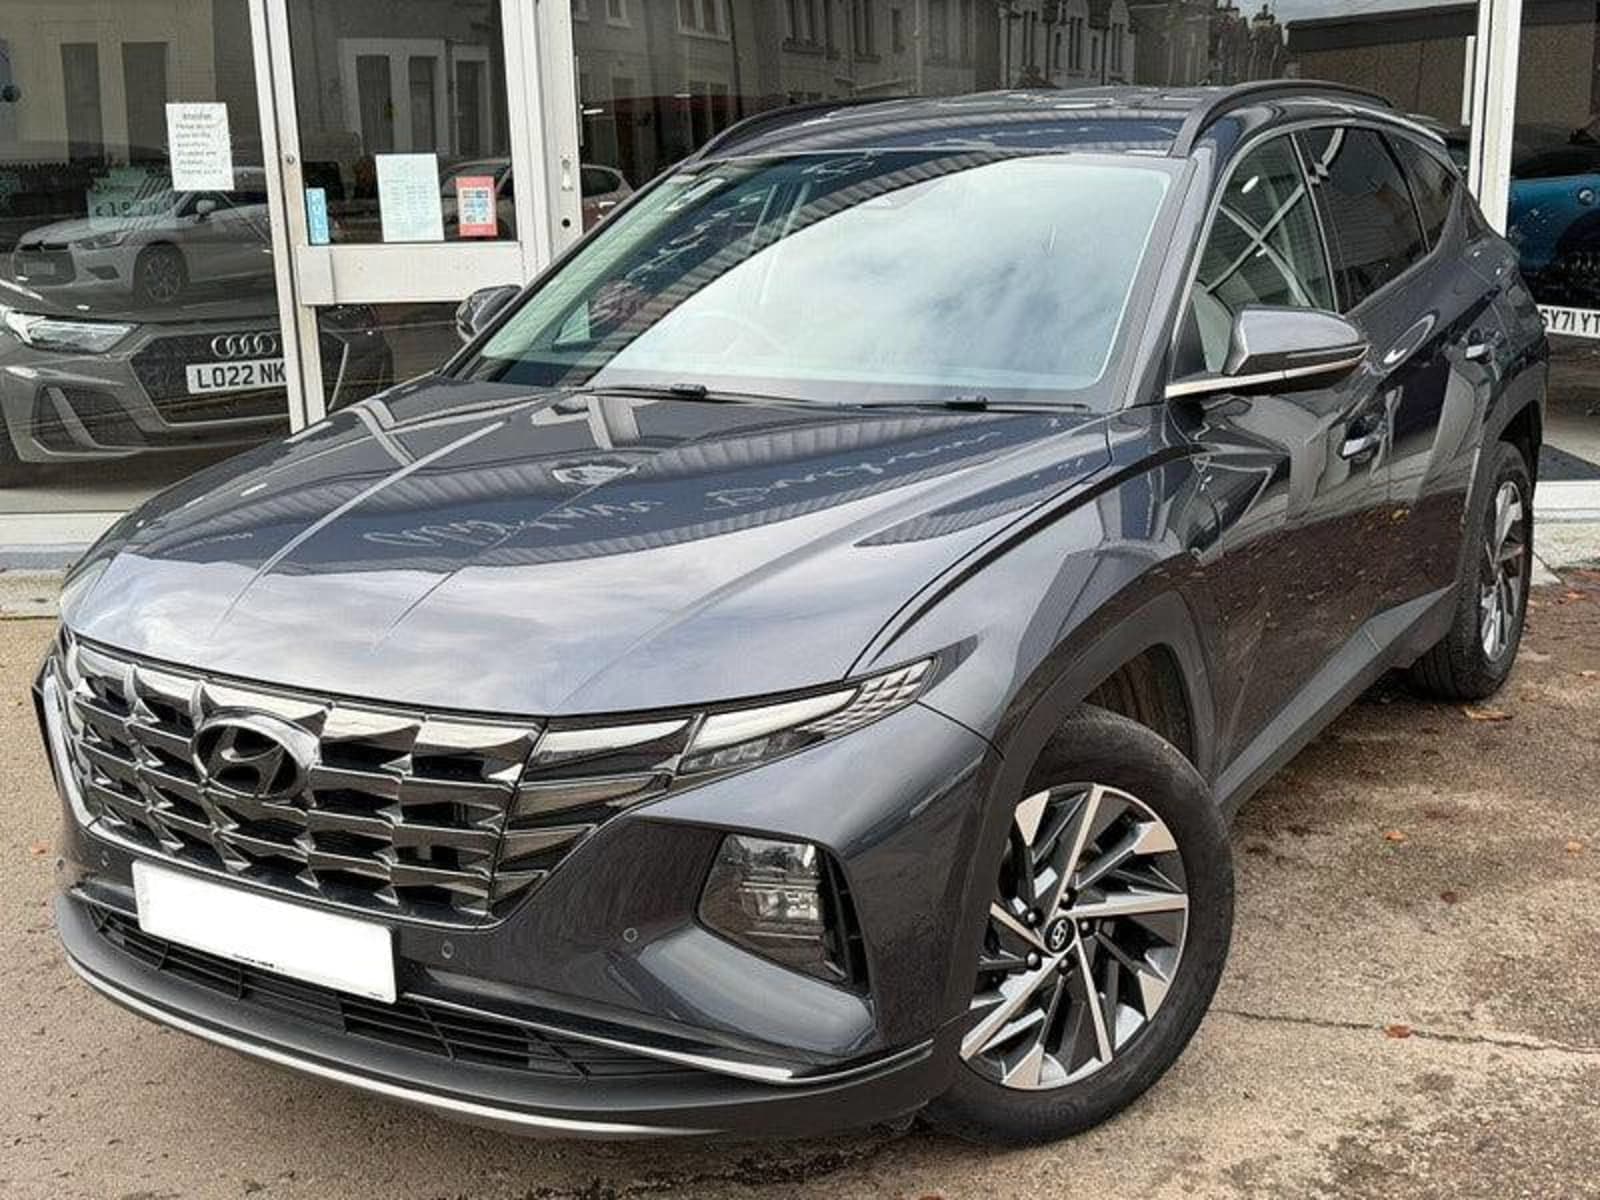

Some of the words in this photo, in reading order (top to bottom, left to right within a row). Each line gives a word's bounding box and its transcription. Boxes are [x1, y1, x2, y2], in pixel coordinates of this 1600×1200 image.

[1539, 308, 1576, 331] SY71
[1581, 312, 1600, 334] YT
[259, 362, 287, 384] NK
